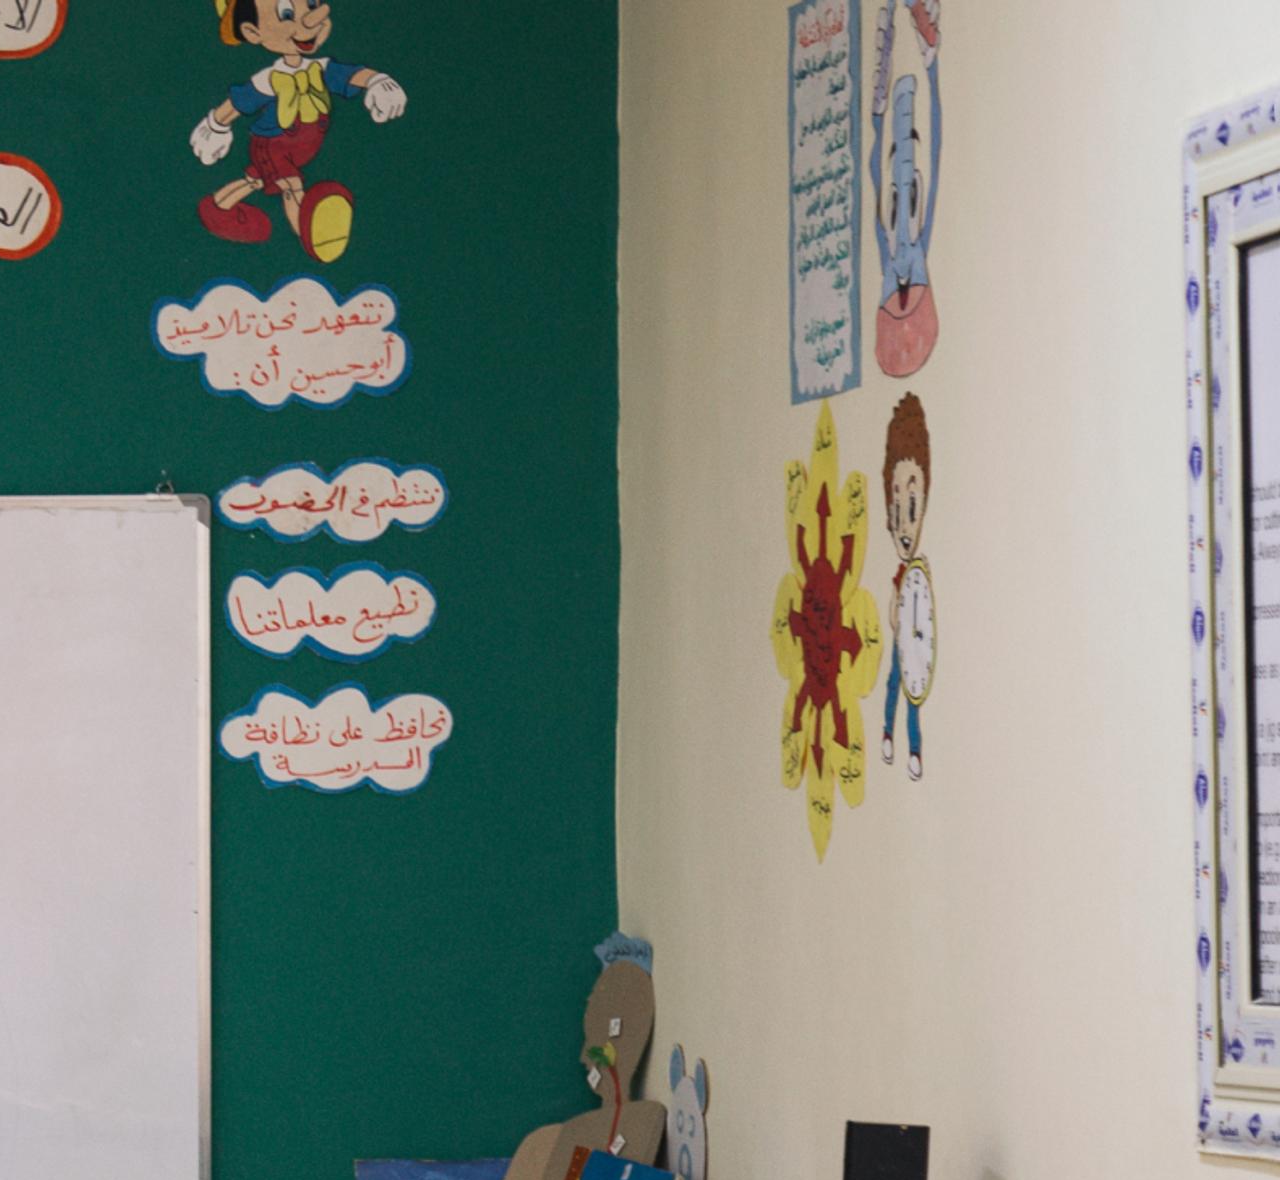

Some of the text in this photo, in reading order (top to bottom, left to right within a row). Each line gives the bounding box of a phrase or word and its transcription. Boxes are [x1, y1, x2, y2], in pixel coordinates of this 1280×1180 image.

[302, 301, 387, 337] نتعهد
[234, 583, 420, 645] نطيع معلماتنا
[243, 706, 448, 749] نحافظ على نظافة
[272, 745, 424, 779] المدرسة
